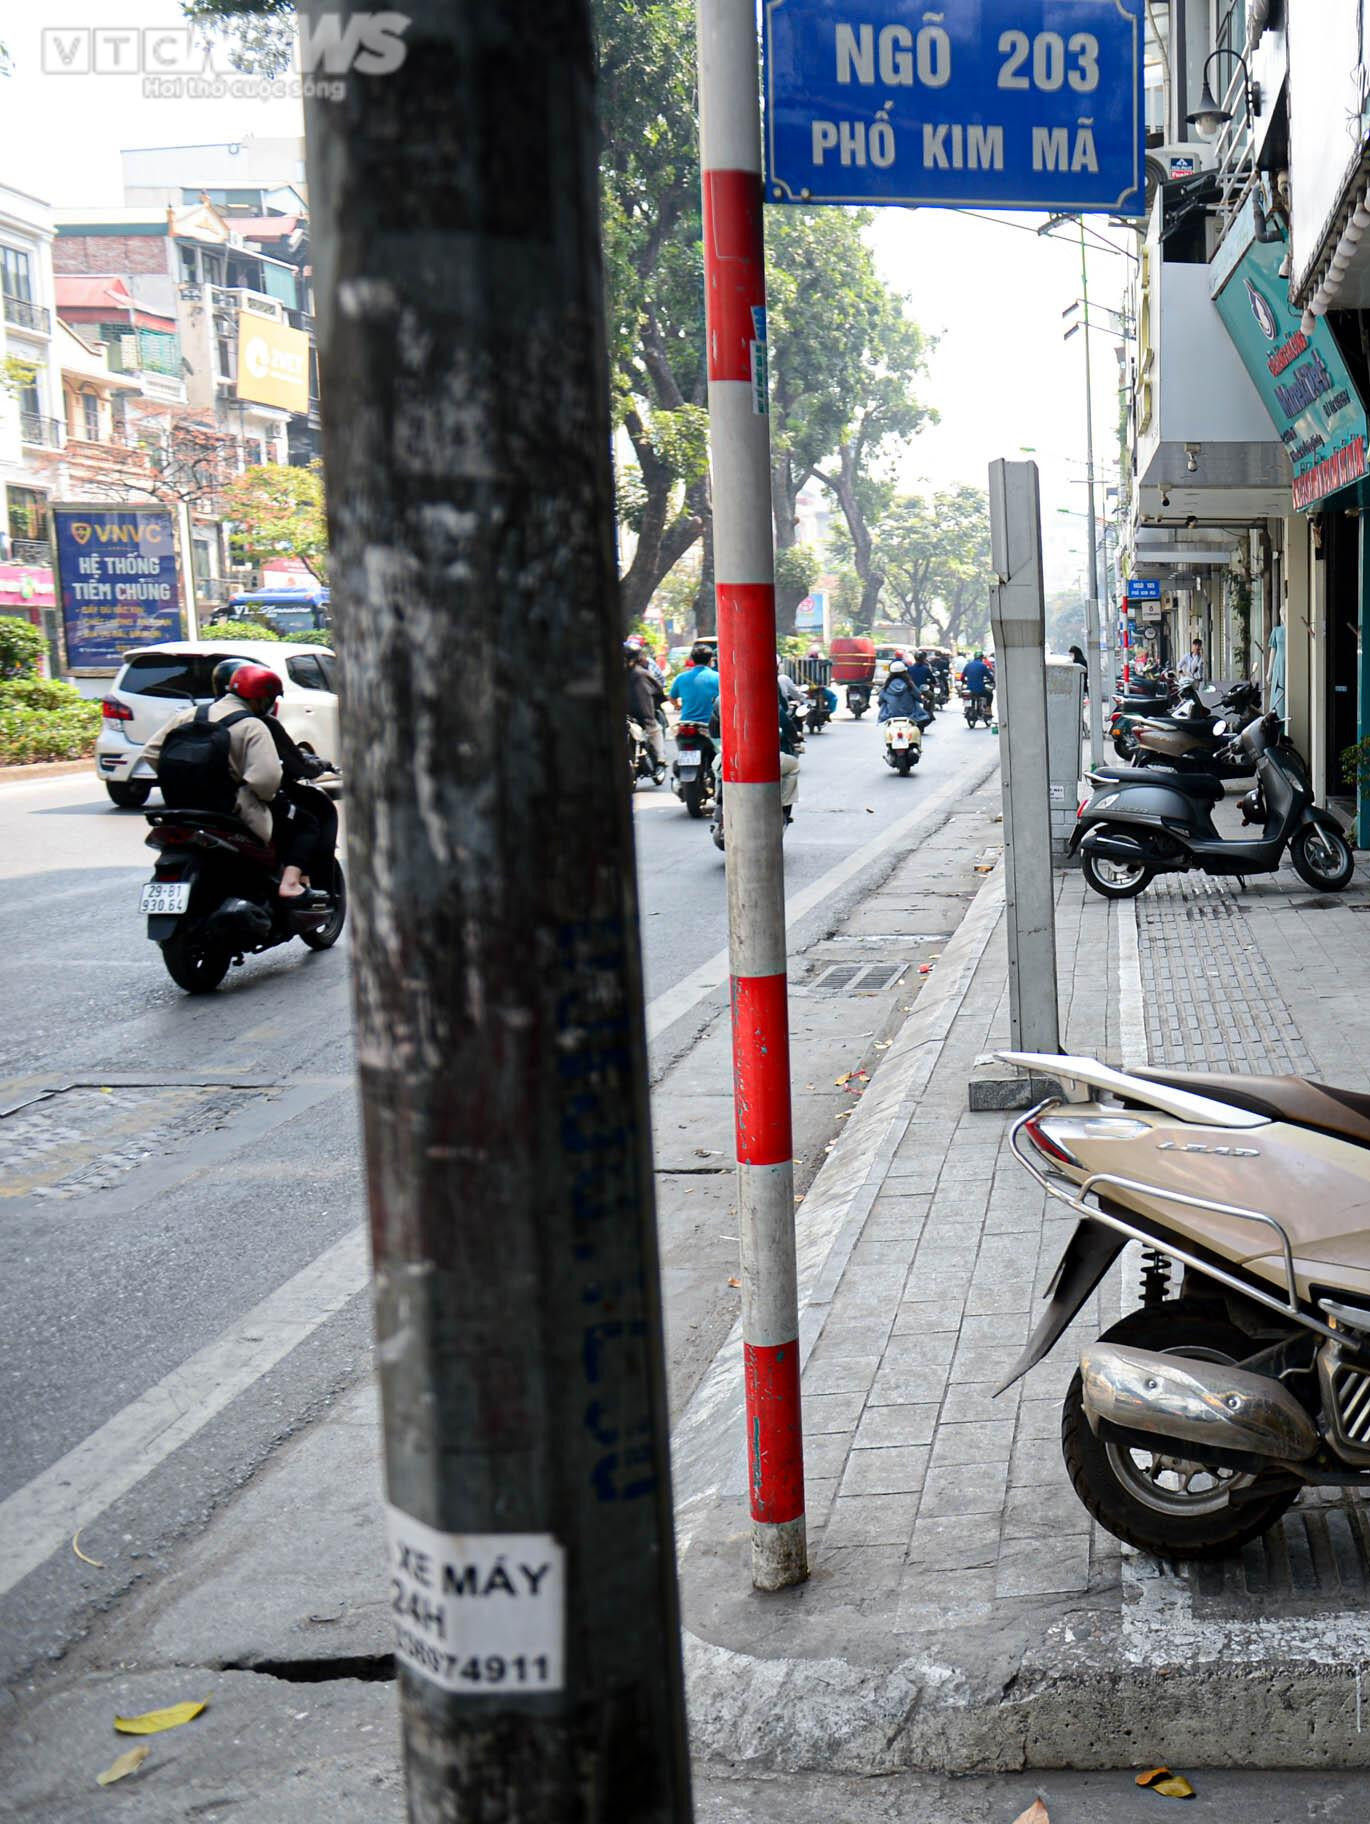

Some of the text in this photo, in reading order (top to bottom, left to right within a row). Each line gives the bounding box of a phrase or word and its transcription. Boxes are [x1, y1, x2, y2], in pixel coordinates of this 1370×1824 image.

[834, 12, 1101, 92] NGÕ 203
[811, 101, 1100, 174] PHỐ KIM MÃ
[95, 524, 161, 543] VNVC
[78, 551, 160, 579] HỆ THỐNG
[71, 578, 112, 600] TIÊM
[442, 1554, 550, 1598] MÁY
